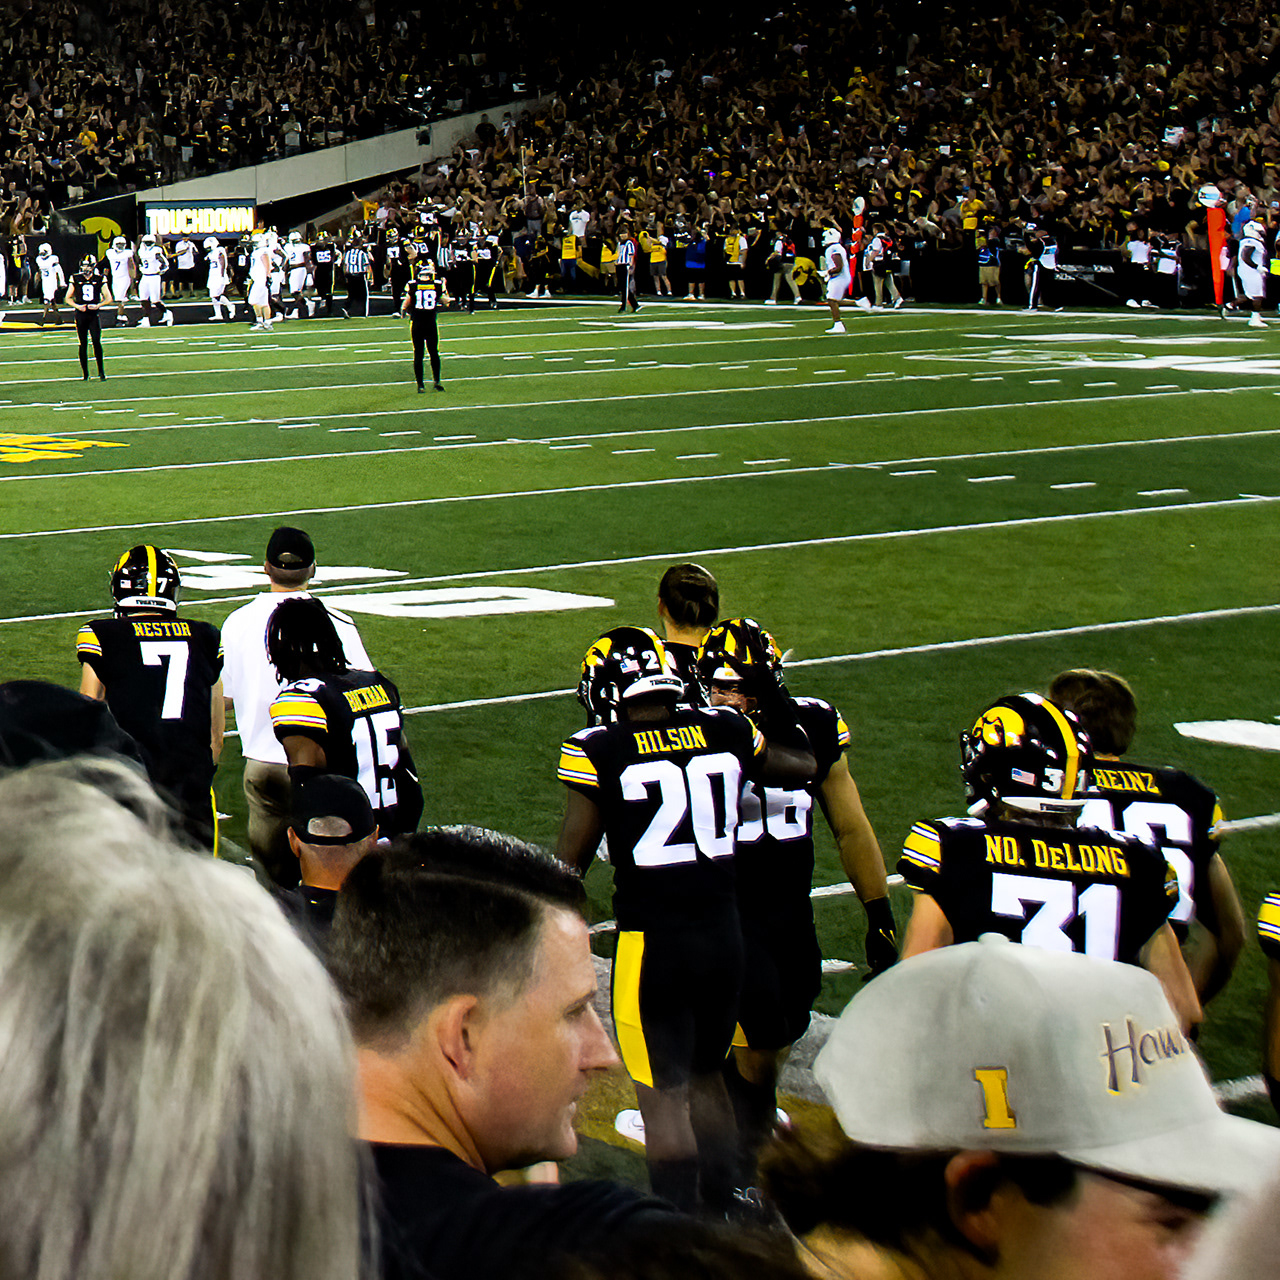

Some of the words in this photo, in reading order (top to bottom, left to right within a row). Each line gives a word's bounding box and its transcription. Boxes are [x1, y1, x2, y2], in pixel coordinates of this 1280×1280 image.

[146, 207, 254, 234] TOUCHDOWN
[81, 283, 95, 302] 9
[415, 289, 437, 310] 18
[156, 577, 168, 594] 7
[132, 622, 191, 637] NESTOR
[140, 641, 189, 719] 7
[633, 725, 707, 754] HILSON
[351, 710, 401, 809] 15
[1093, 768, 1162, 796] HEINZ
[620, 752, 742, 867] 20
[985, 834, 1024, 866] NO.
[1032, 838, 1131, 878] DeLONG
